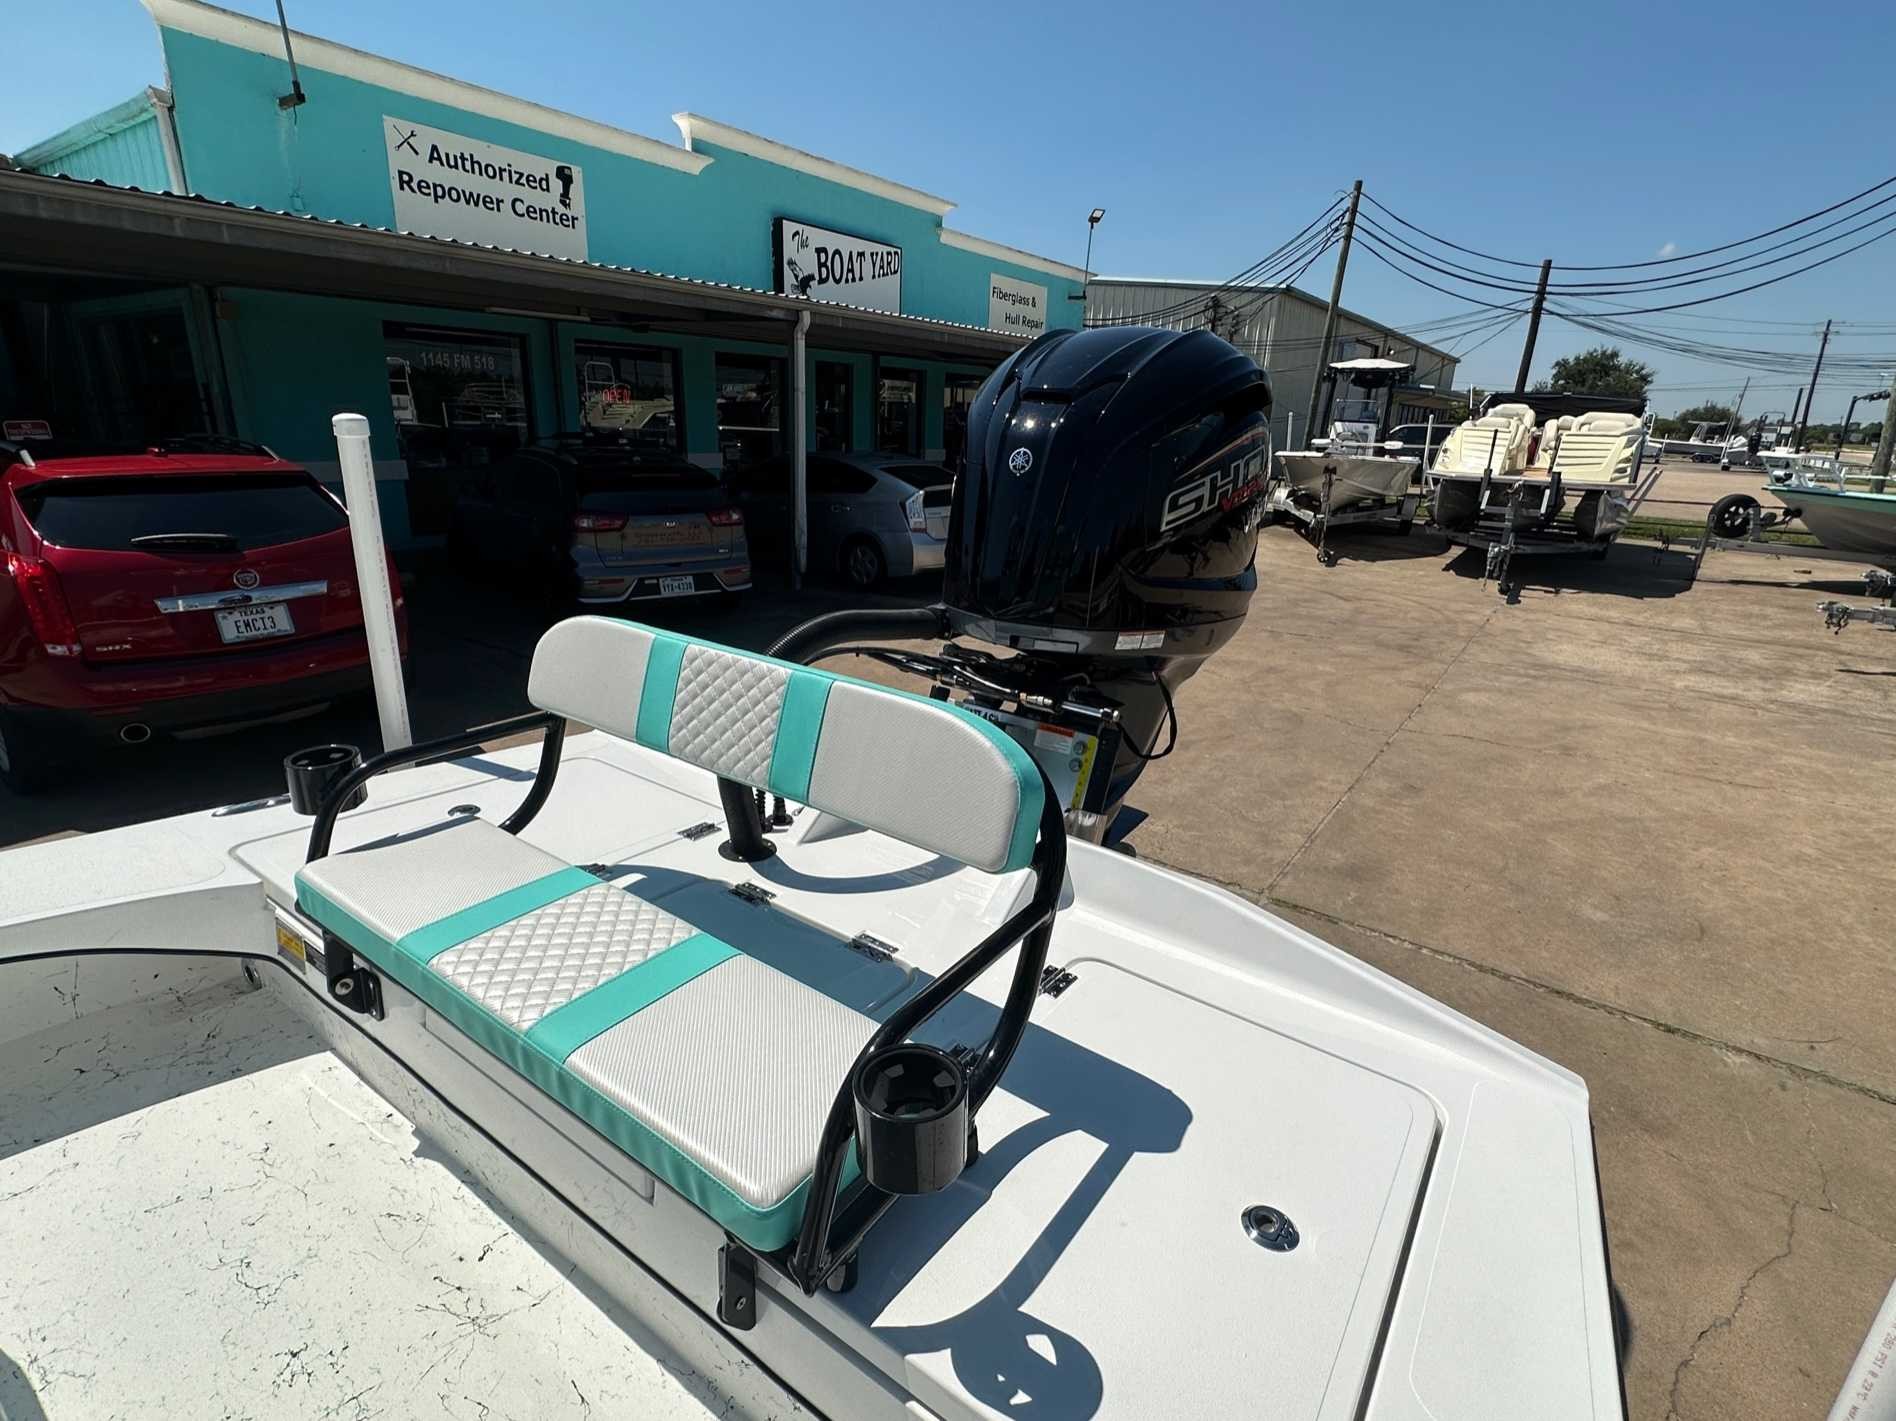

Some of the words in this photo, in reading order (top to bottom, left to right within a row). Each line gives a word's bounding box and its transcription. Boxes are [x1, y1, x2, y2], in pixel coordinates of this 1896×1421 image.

[428, 143, 550, 193] Authorized
[397, 169, 504, 213] Repower
[511, 197, 579, 229] Center
[791, 230, 809, 254] The
[815, 246, 866, 285] BOAT
[870, 248, 900, 280] YARD
[991, 286, 1030, 308] Fiberglass
[1030, 296, 1037, 308] &
[1004, 312, 1020, 326] Hull
[1021, 316, 1044, 330] Repair
[239, 607, 265, 617] TEXAS
